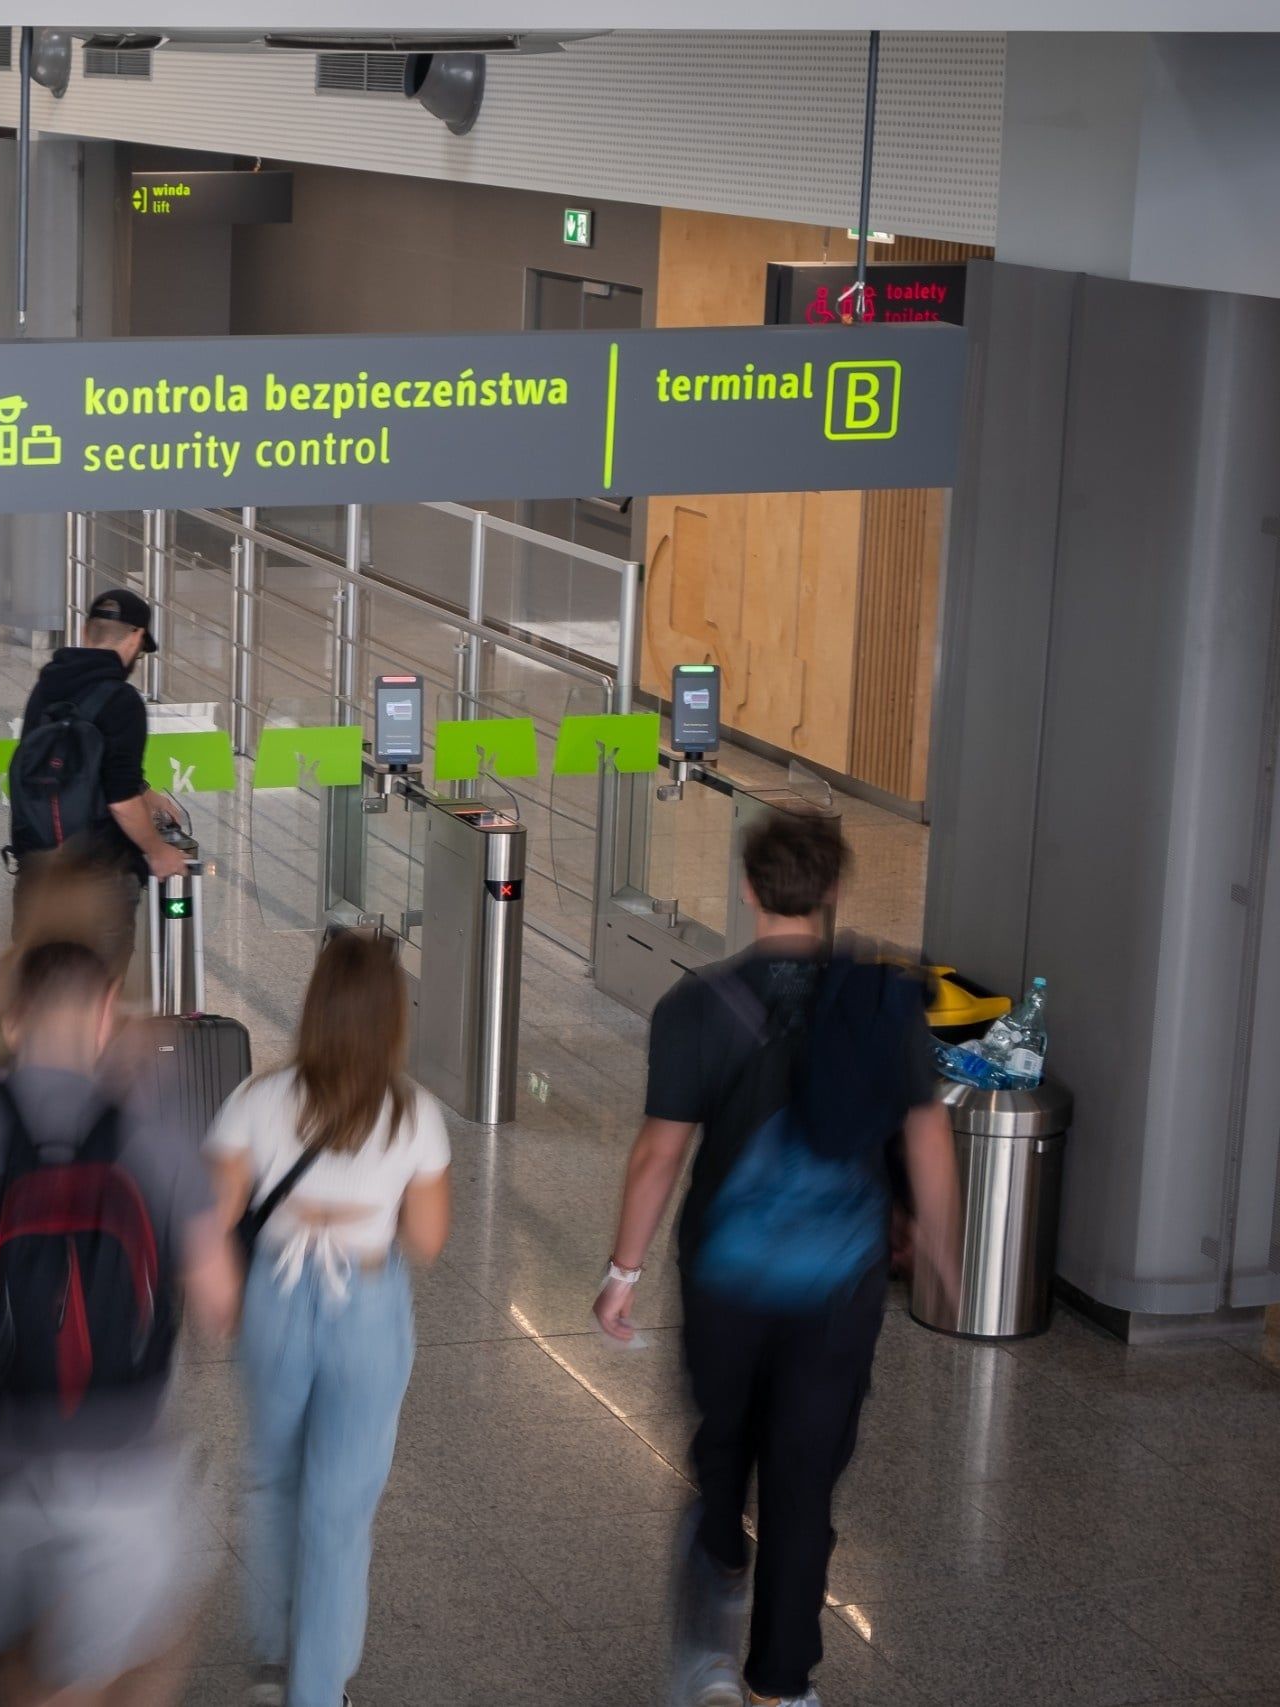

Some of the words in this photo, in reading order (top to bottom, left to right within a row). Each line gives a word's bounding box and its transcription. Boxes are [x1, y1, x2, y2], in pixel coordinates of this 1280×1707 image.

[152, 184, 190, 196] winda
[152, 201, 170, 213] lift
[886, 282, 946, 303] toalety
[85, 375, 248, 414] kontrola
[265, 369, 568, 417] bezpieczeństwa
[656, 361, 813, 403] terminal
[845, 372, 880, 429] B
[84, 432, 240, 477] security
[256, 427, 391, 467] control
